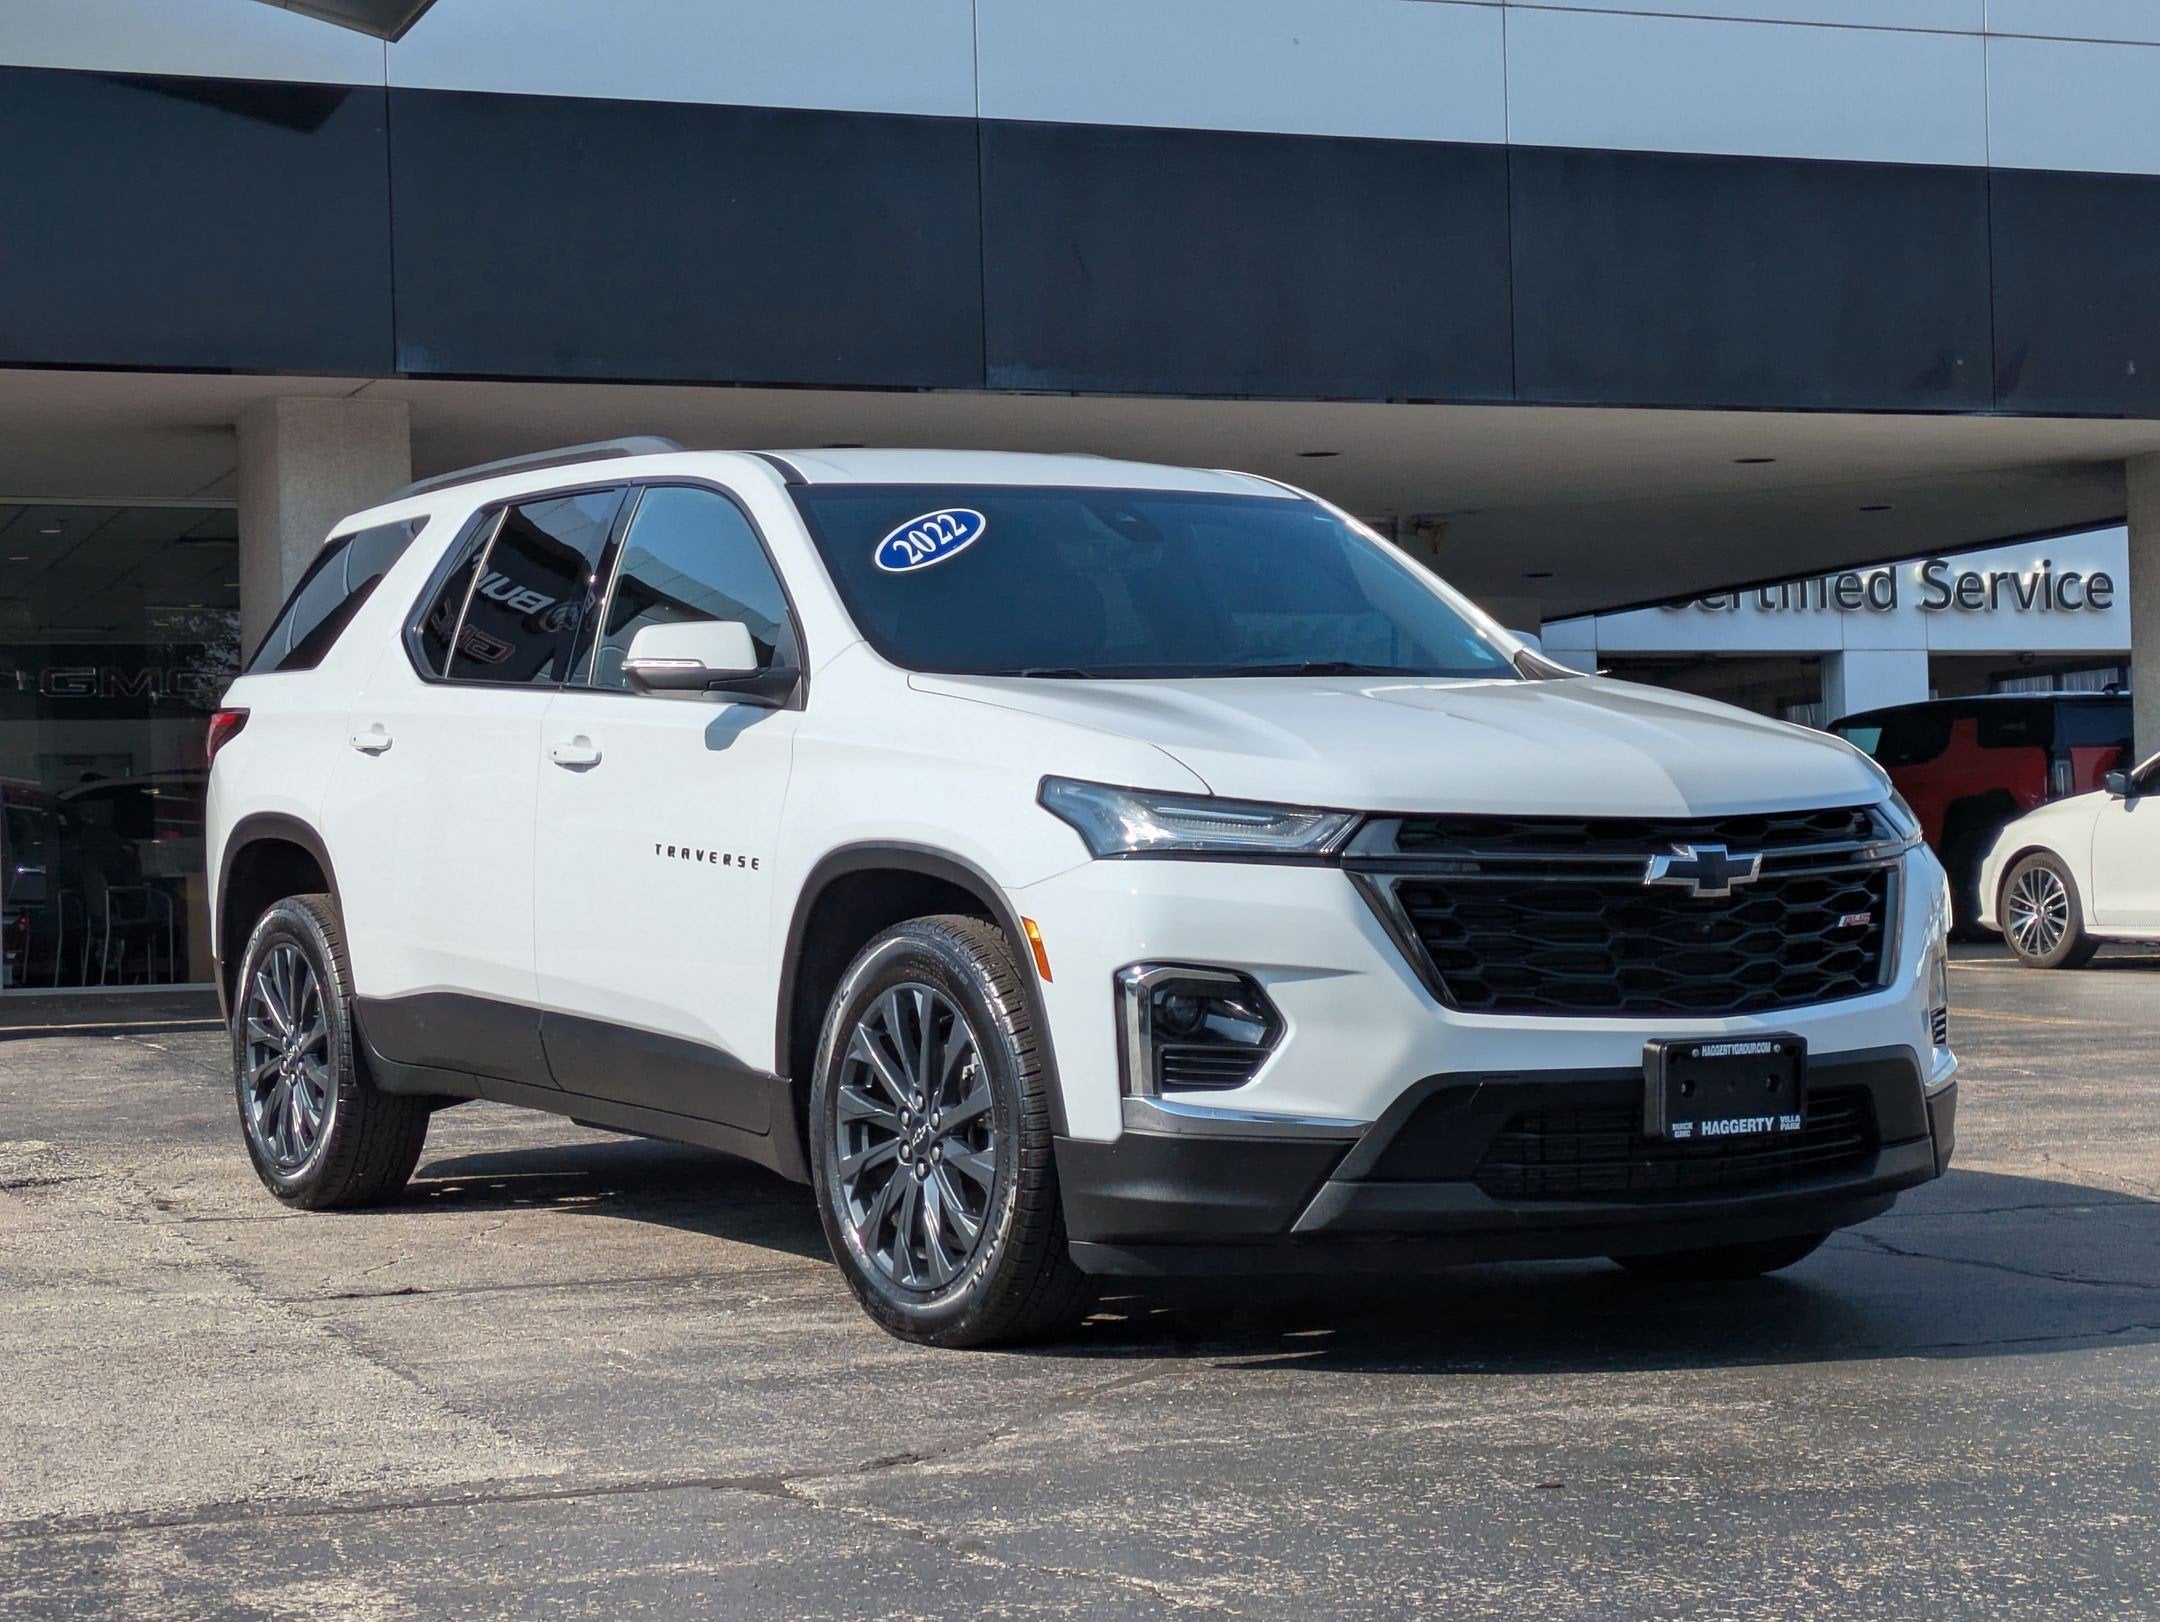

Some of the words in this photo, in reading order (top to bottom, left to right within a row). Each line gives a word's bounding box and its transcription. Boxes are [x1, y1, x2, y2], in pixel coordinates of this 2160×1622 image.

[893, 514, 968, 564] 2022
[1919, 559, 2114, 611] Service
[655, 843, 760, 870] TRAVERSE
[1702, 1117, 1774, 1135] HAGGERTY
